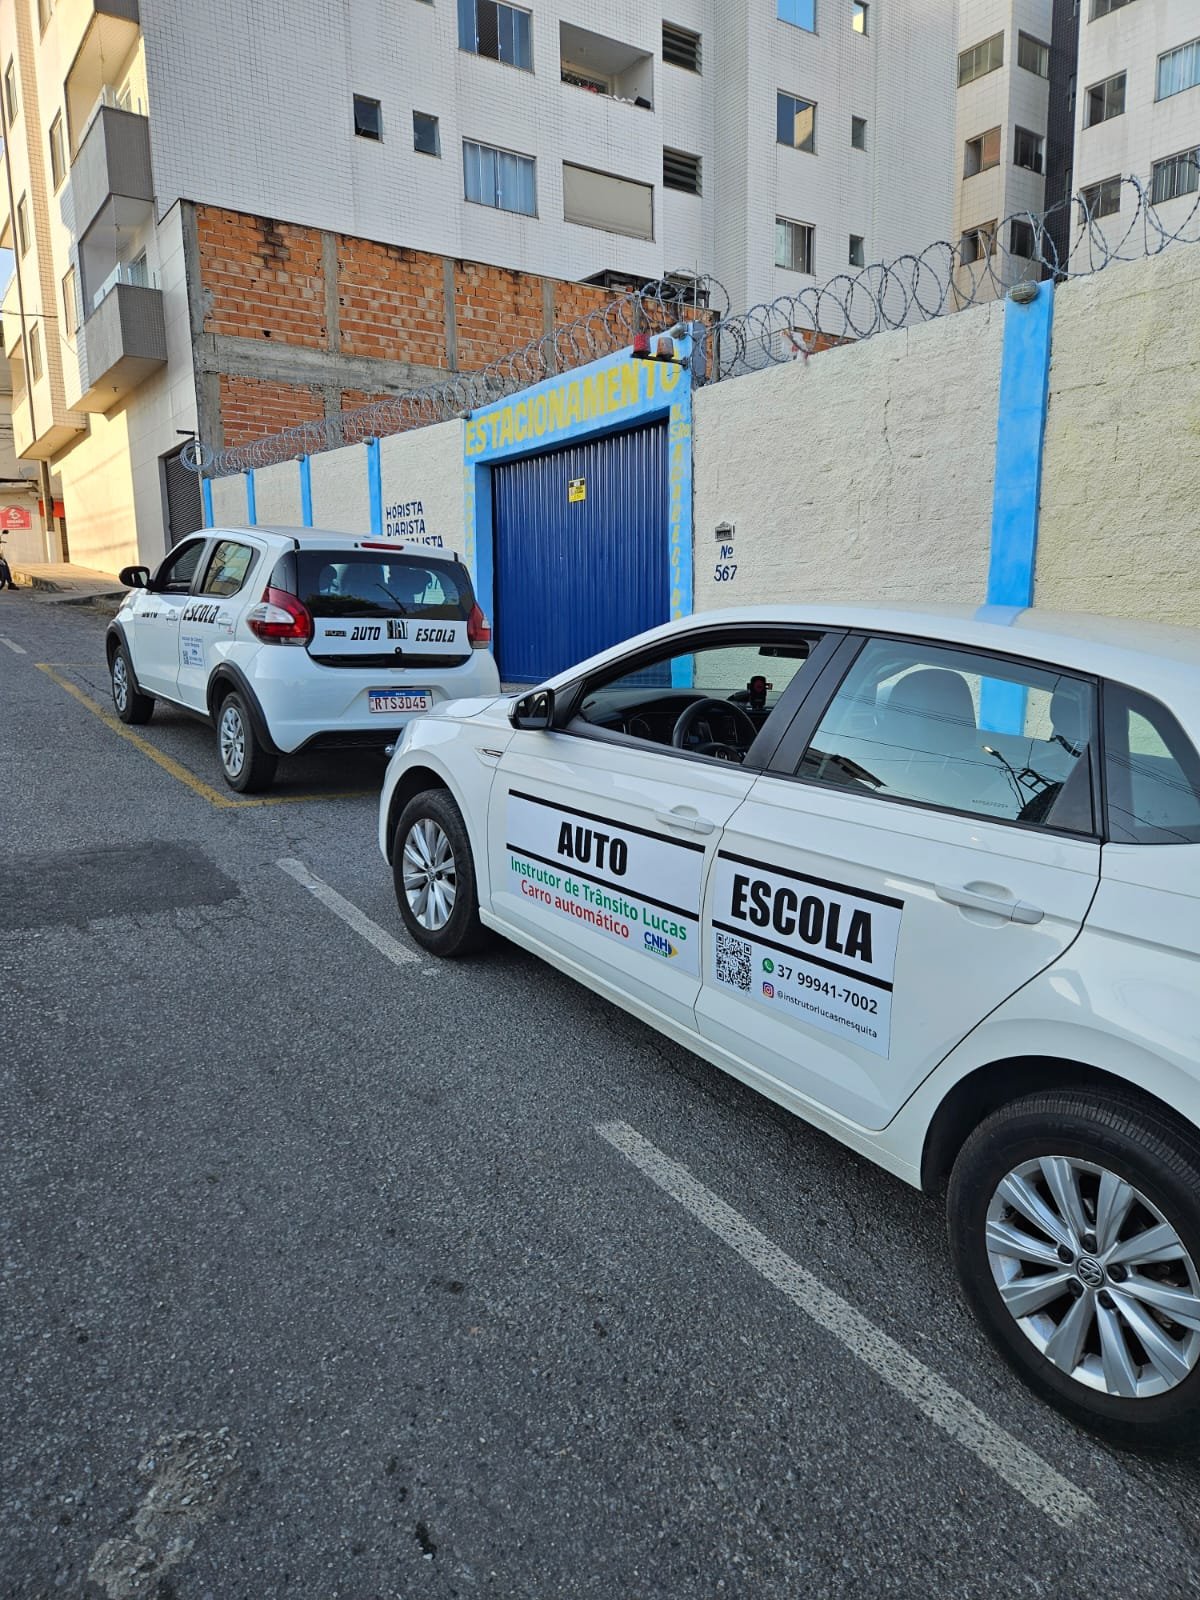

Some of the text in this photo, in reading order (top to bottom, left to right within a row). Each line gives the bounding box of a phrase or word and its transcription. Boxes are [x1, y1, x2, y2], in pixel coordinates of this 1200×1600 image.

[465, 345, 681, 456] ESTACIONAMENTO
[713, 564, 738, 582] 567
[350, 626, 382, 641] AUTO
[415, 628, 456, 643] ESCOLA
[374, 696, 427, 711] RTS3D45
[557, 821, 629, 877] AUTO
[510, 855, 688, 942] Instrutor de Trânsito Lucas
[520, 878, 630, 939] Carro automático
[730, 873, 874, 965] ESCOLA
[643, 931, 668, 952] CNH
[776, 989, 879, 1039] @instrutorlucasmesquita
[777, 963, 879, 1016] 37 99941-7002
